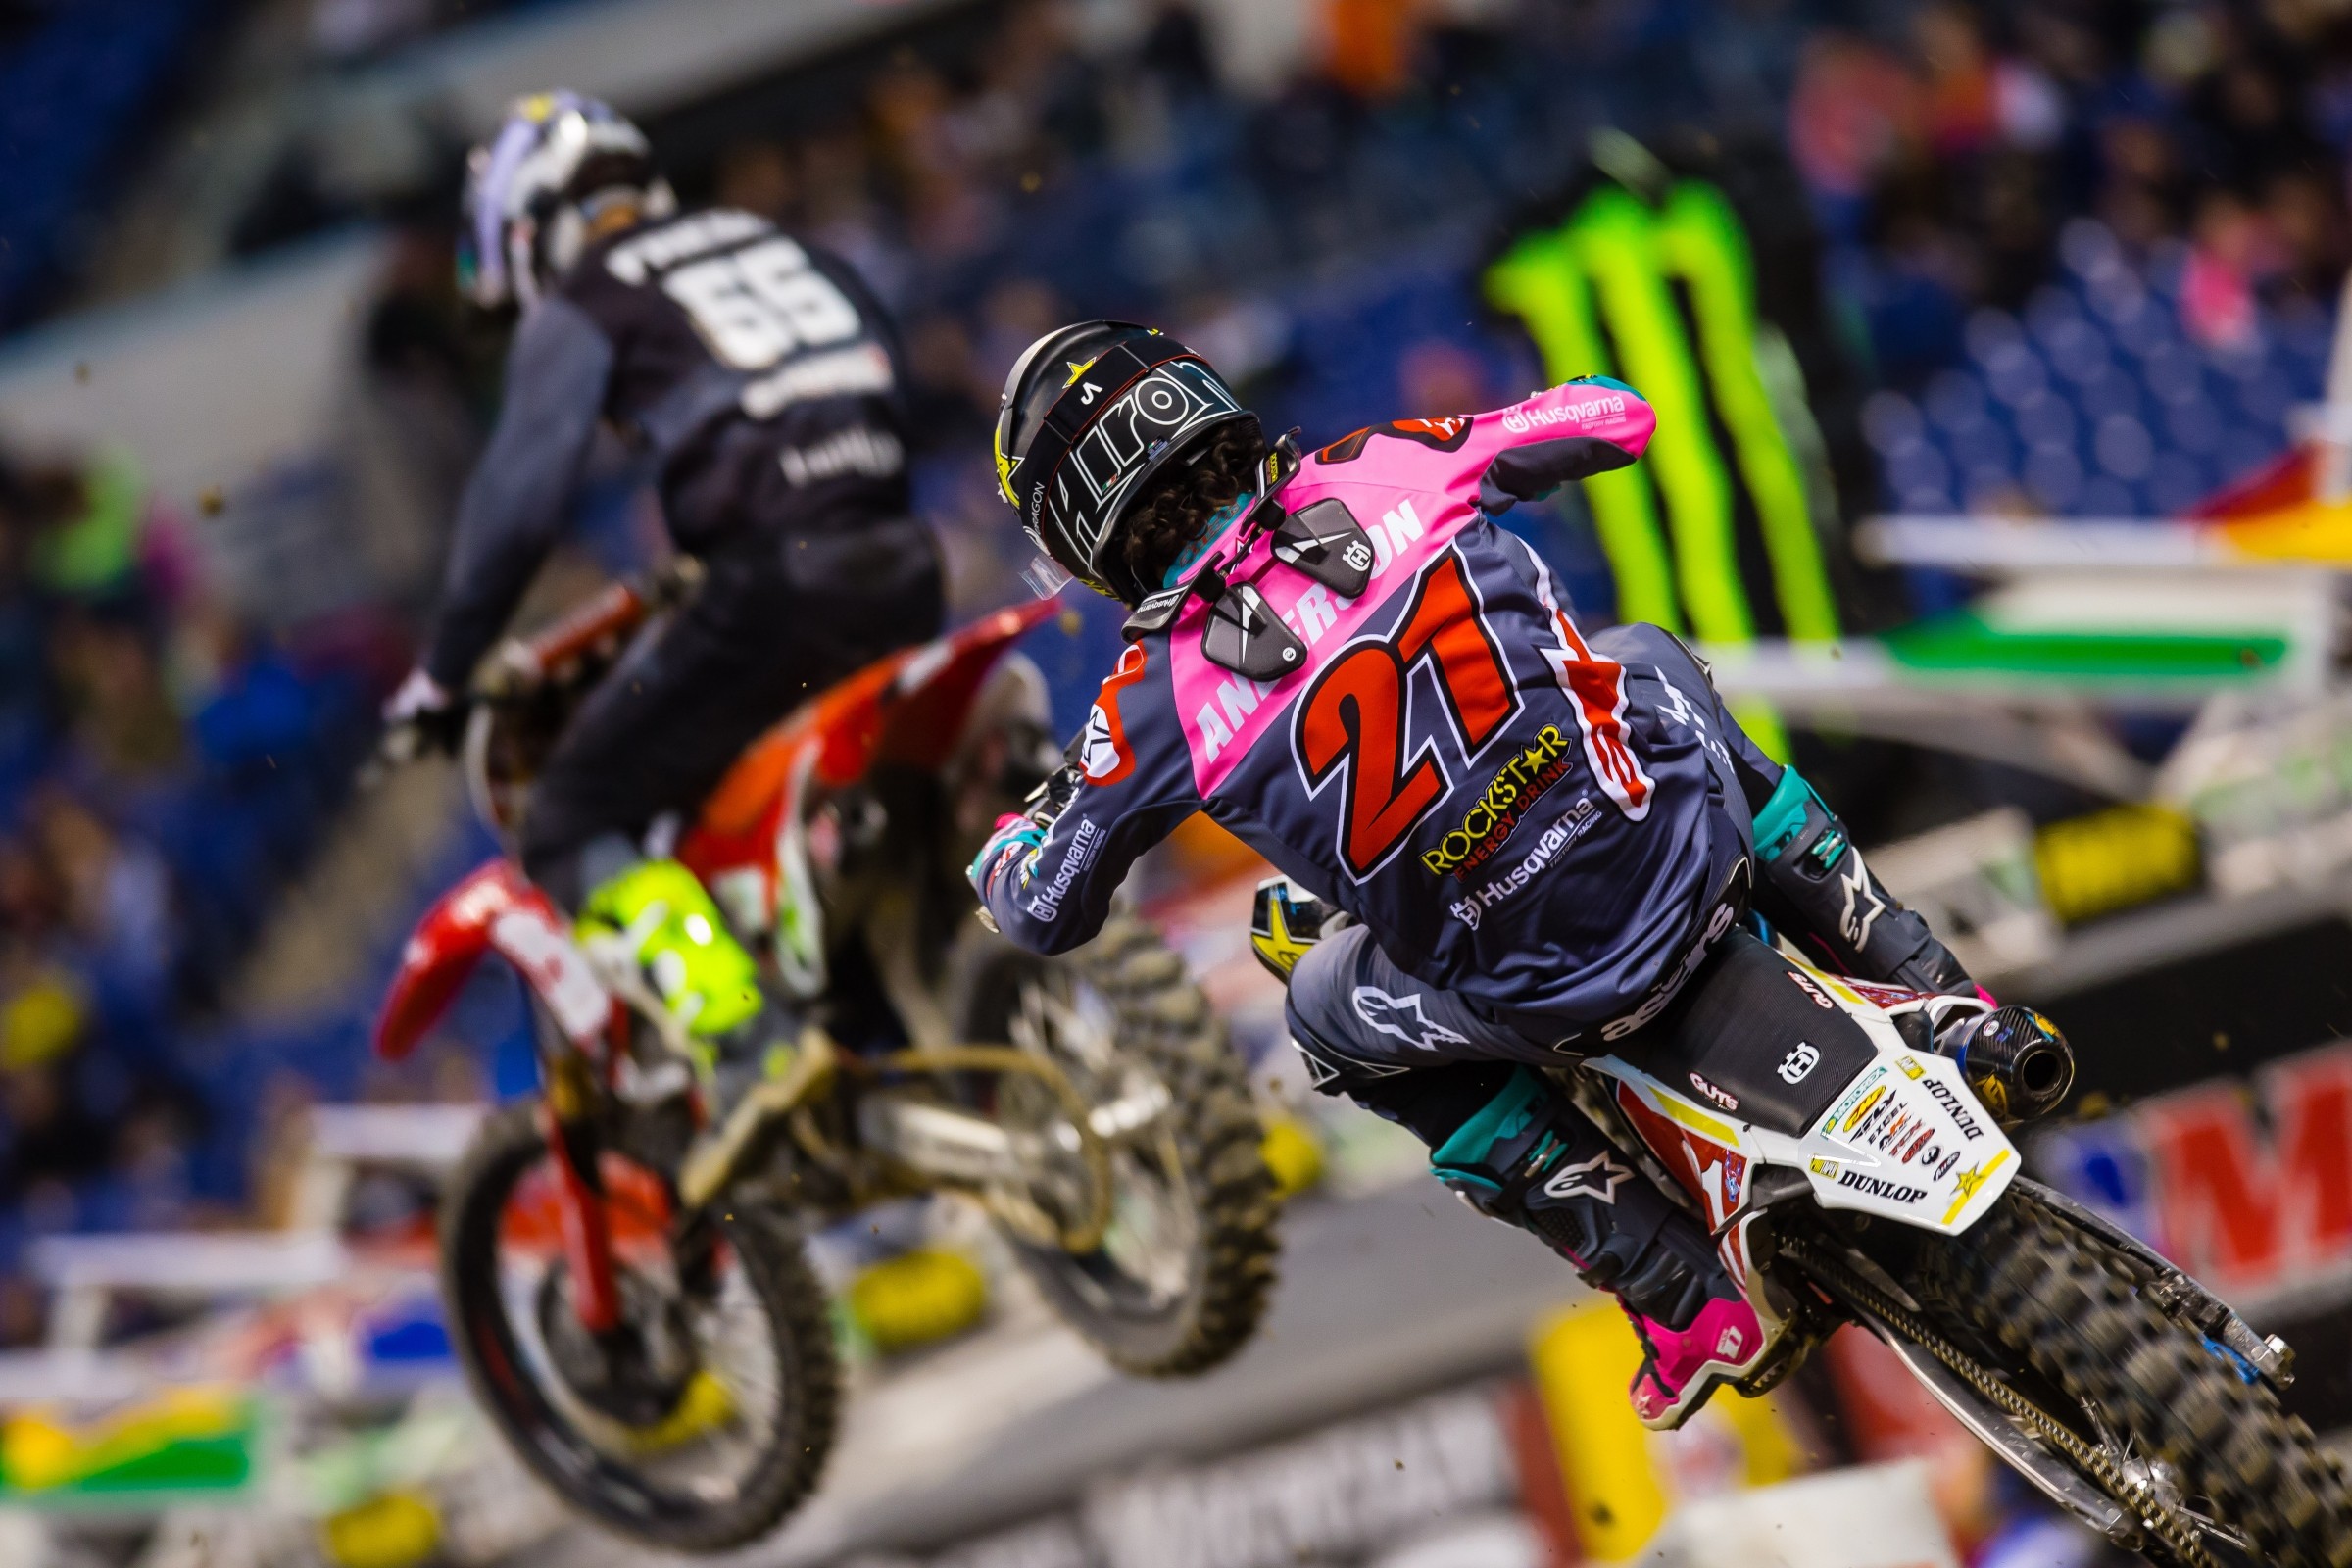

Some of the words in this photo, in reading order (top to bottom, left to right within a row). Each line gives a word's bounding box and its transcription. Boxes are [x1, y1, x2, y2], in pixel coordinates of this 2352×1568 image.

[1525, 395, 1625, 426] Husqvarna
[1195, 499, 1425, 763] ANRON
[1290, 540, 1525, 884] 21
[1454, 812, 1516, 881] ENERGY
[1516, 759, 1571, 810] DRINK
[1577, 809, 1602, 839] RACING
[1042, 817, 1096, 906] Husqvarna
[1480, 796, 1594, 906] Husqvarna
[1689, 1072, 1739, 1110] GUTS
[1833, 1068, 1885, 1119] MOTOREX
[1856, 1090, 1897, 1138] FLY
[1923, 1078, 1984, 1141] DUNLOP
[1868, 1102, 1907, 1145] EXCEL
[1838, 1170, 1928, 1204] DUNLOP
